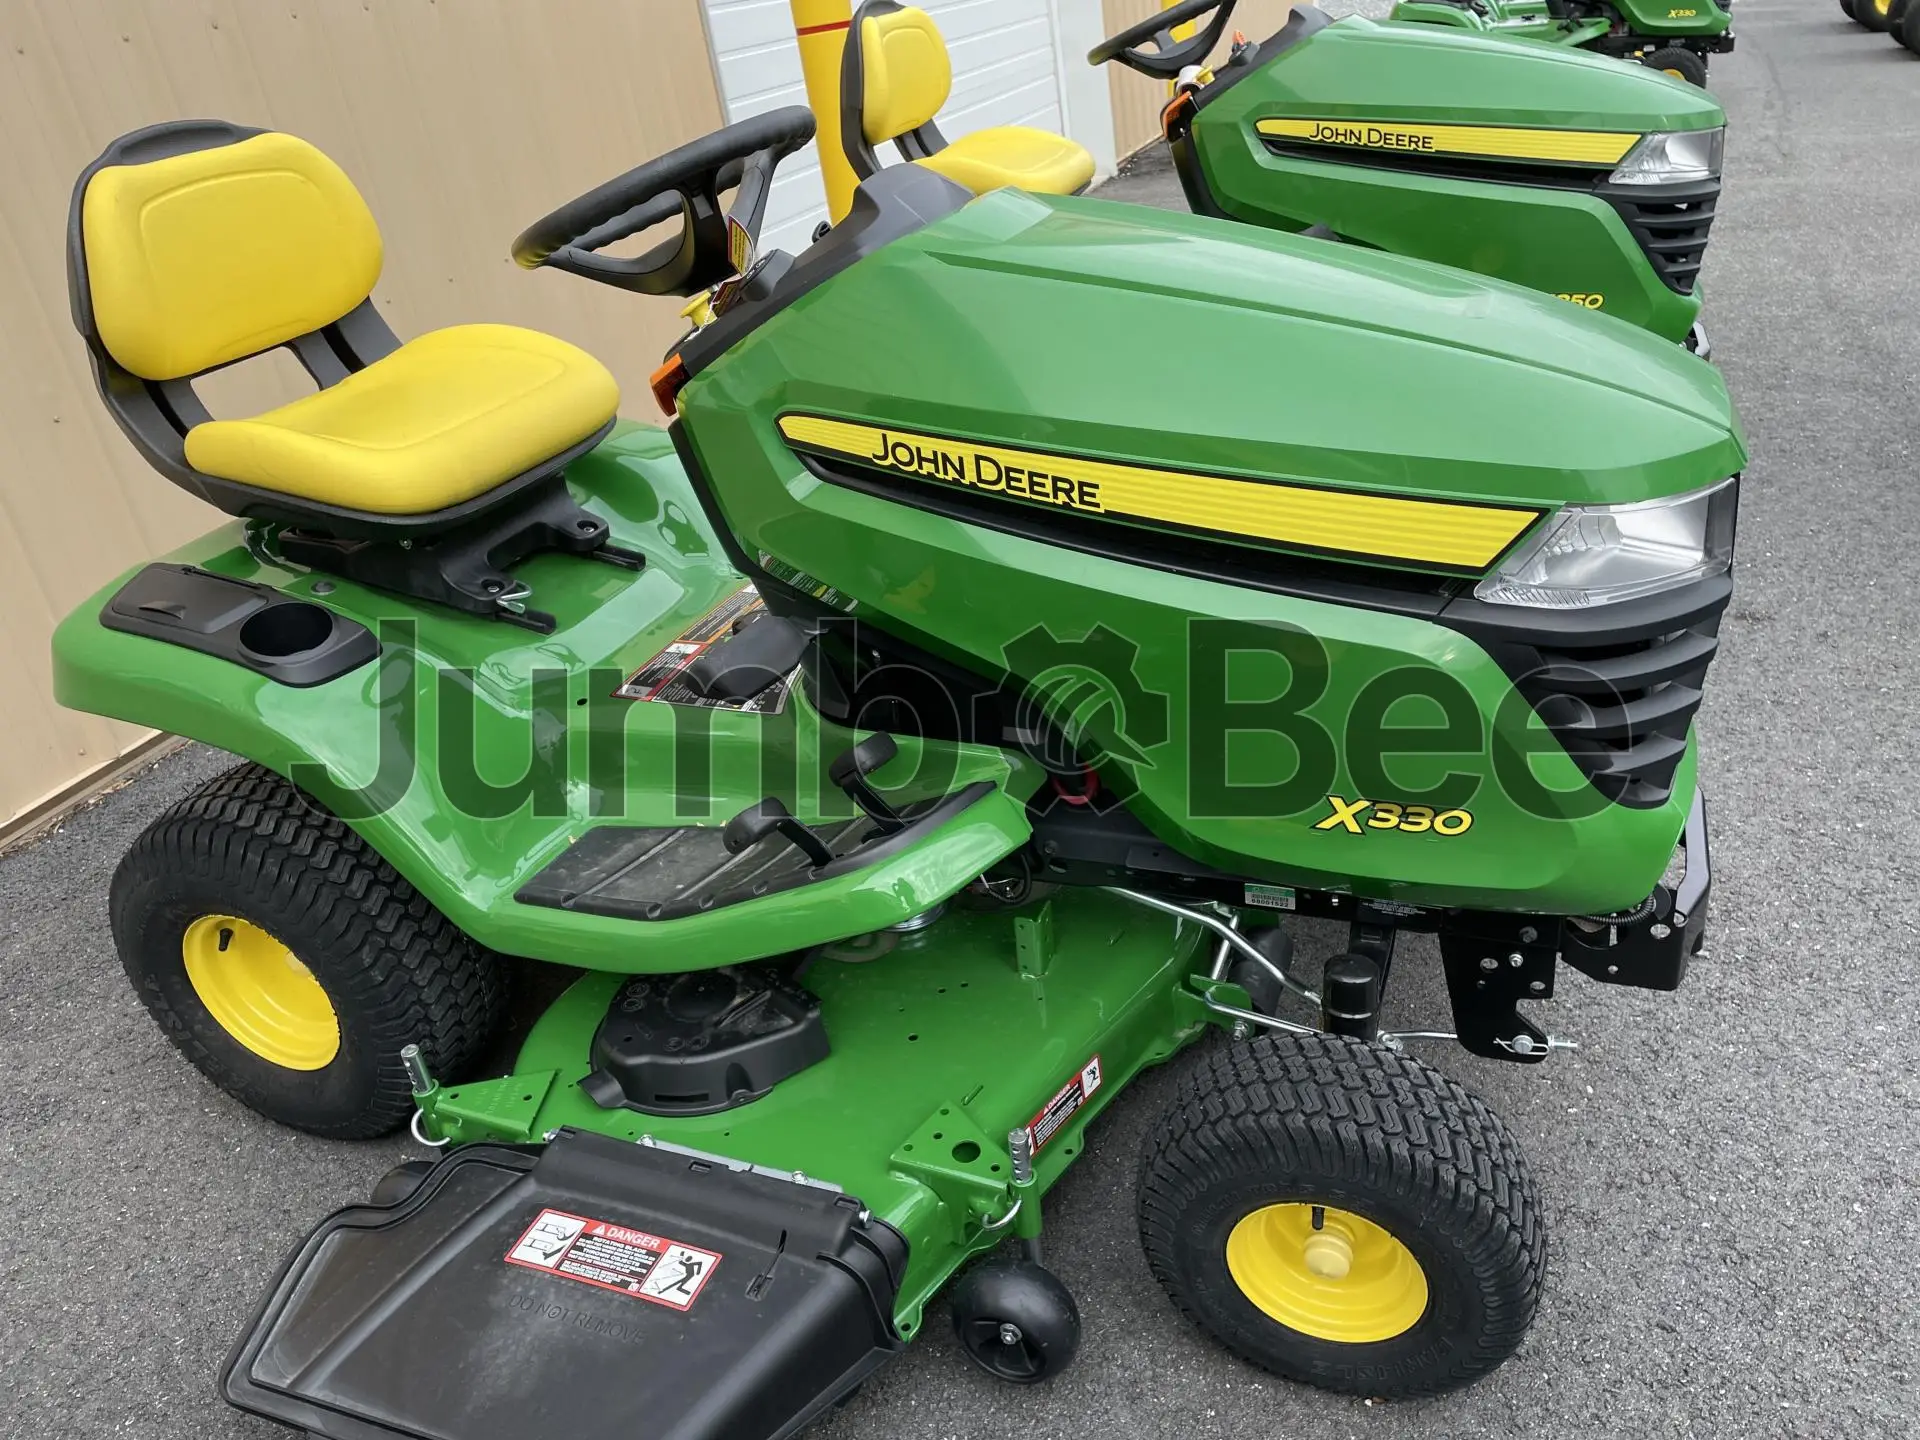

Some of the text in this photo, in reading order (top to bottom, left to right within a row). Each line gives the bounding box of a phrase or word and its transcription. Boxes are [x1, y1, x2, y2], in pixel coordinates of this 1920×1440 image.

[1667, 9, 1697, 18] X330
[1309, 123, 1434, 149] JOHN DEERE
[872, 433, 1101, 509] JOHN DEERE
[1310, 794, 1474, 836] X330
[606, 1227, 661, 1249] DANGER
[508, 1294, 647, 1345] DO NOT REMOVE
